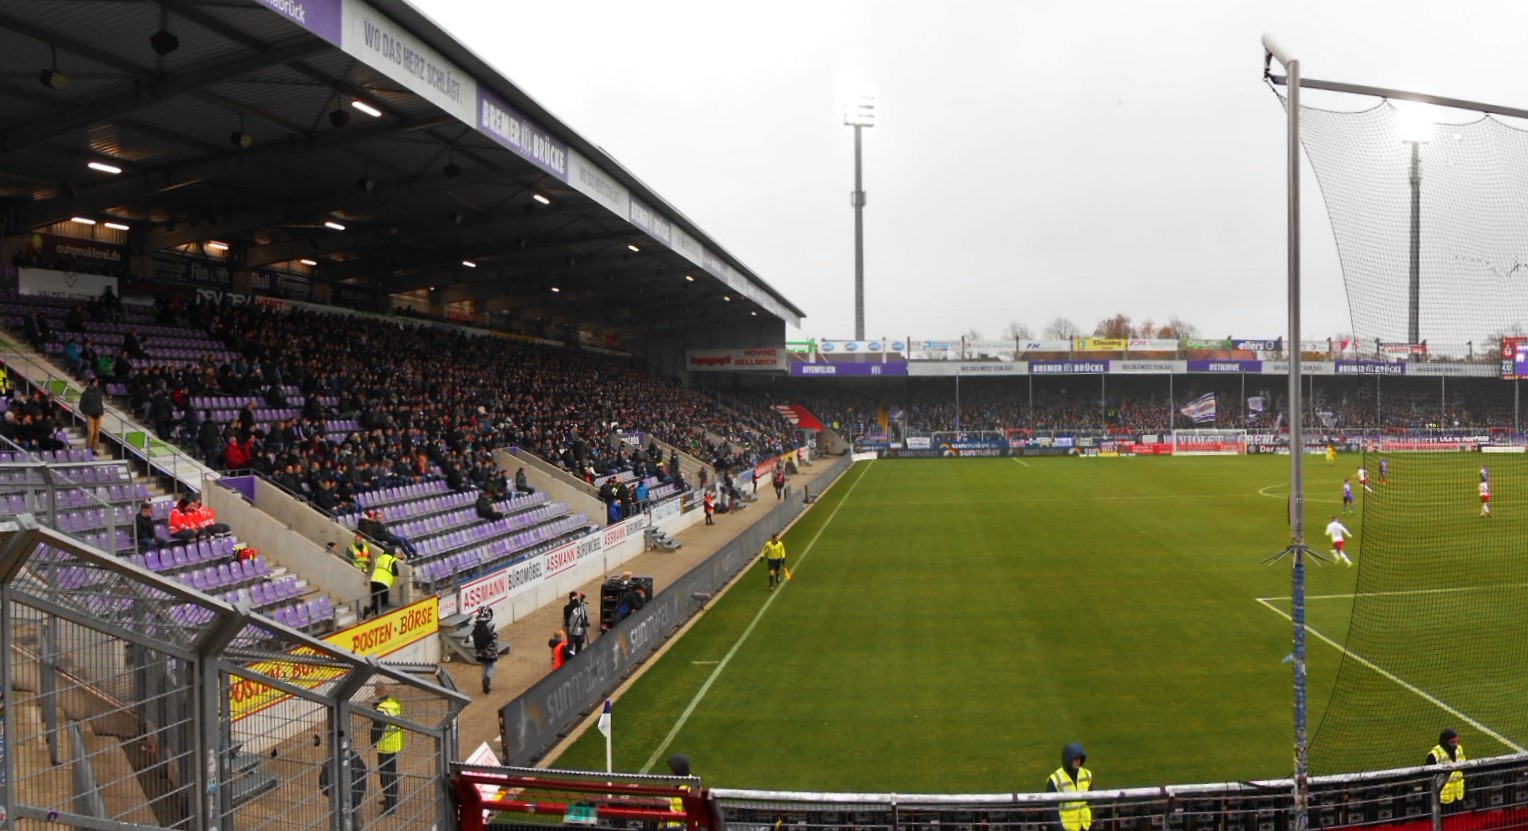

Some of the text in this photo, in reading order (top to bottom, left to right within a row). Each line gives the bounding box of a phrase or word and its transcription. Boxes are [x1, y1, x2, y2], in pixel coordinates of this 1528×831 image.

[364, 21, 380, 52] WO
[383, 33, 401, 65] DAS
[404, 47, 425, 80] HERZ
[482, 99, 520, 147] BREMER
[533, 134, 565, 174] BRÜCKE
[1238, 340, 1263, 350] ellers
[1032, 363, 1062, 372] BREMER
[1074, 362, 1104, 372] BRÜCKE
[1208, 363, 1239, 371] OSTKURVE
[897, 449, 939, 457] sunmaker
[958, 448, 1001, 457] sunmaker
[1023, 447, 1064, 455] sunmaker
[1259, 445, 1274, 453] Der
[604, 525, 627, 546] ASSMANN
[546, 535, 602, 572] ASSMANN BÜROMÖBEL
[464, 561, 543, 609] ASSMANN BÜROMÖBEL
[352, 606, 434, 653] POSTEN BÖRSE
[629, 599, 670, 654] sunmaker
[546, 650, 608, 726] sunmaker
